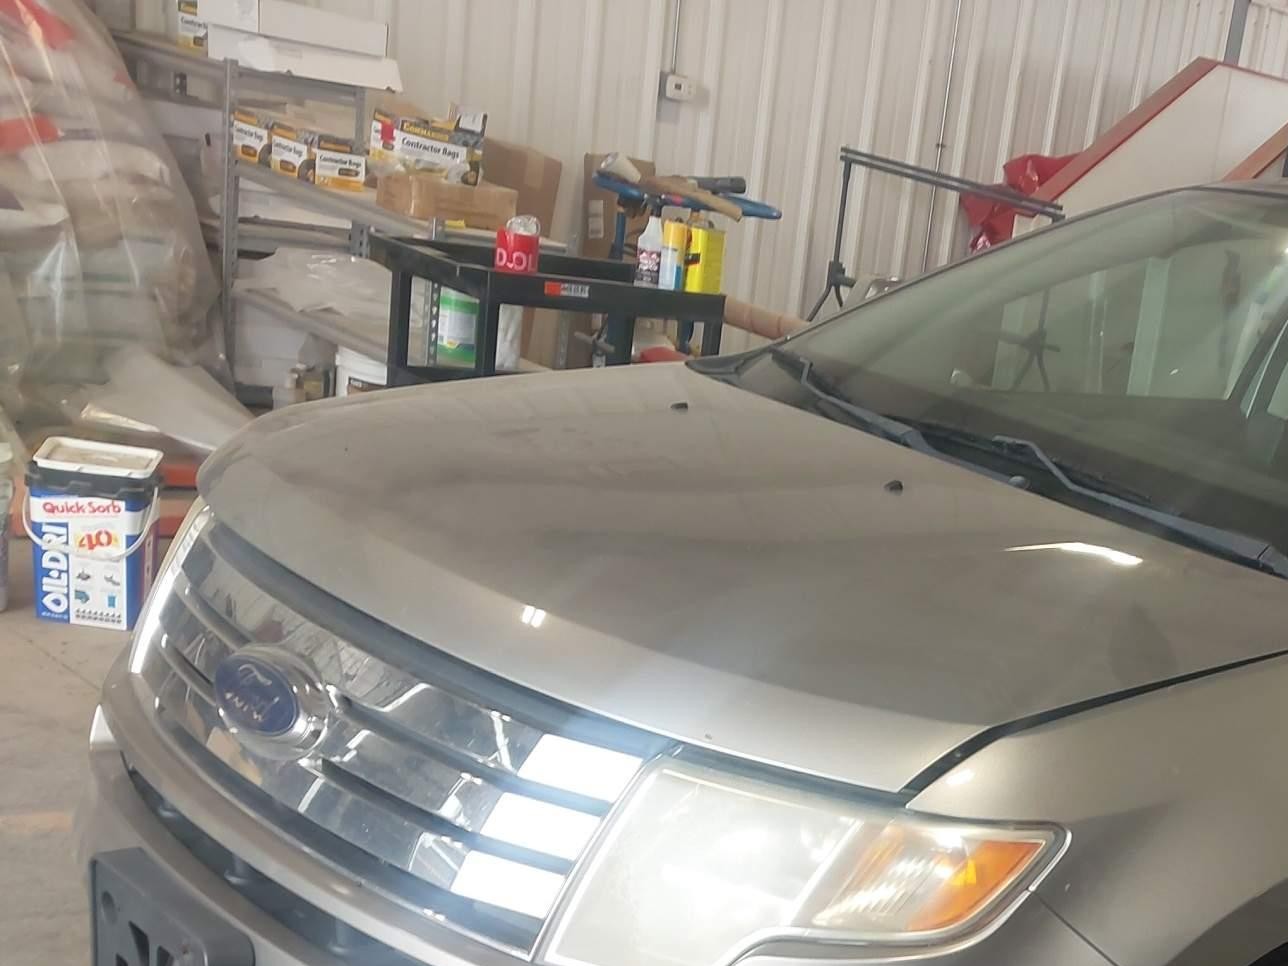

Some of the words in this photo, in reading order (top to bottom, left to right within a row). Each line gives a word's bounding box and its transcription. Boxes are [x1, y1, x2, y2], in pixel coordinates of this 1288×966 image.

[402, 137, 441, 156] Contractor
[442, 148, 460, 161] Bags
[42, 501, 86, 515] Quick
[87, 501, 122, 514] Sorb
[78, 529, 113, 551] 40
